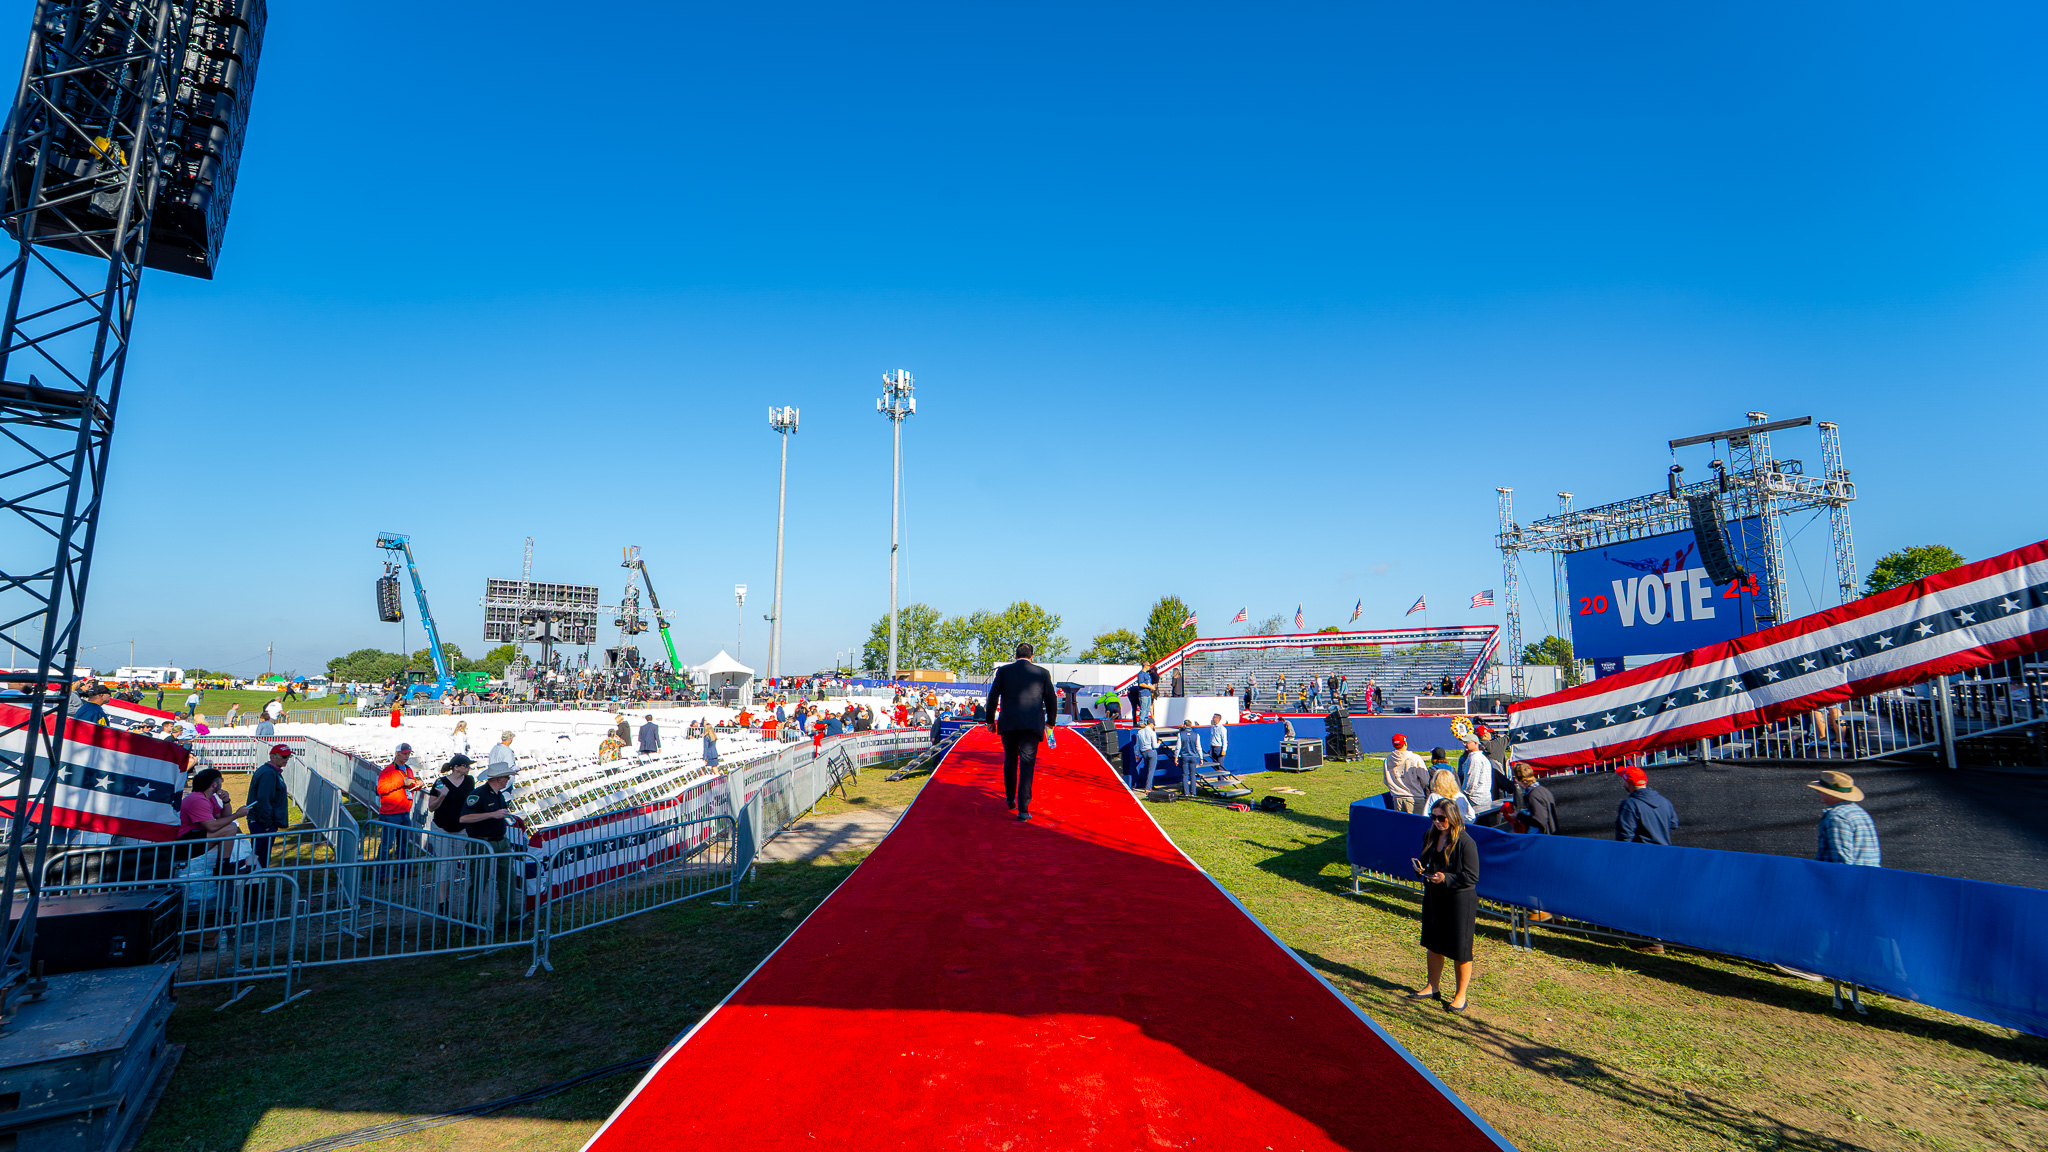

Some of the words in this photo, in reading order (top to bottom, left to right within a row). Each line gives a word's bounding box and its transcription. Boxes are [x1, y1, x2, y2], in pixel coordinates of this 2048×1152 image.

[1579, 594, 1608, 615] 20
[1611, 567, 1716, 627] VOTE
[1723, 574, 1760, 598] 24
